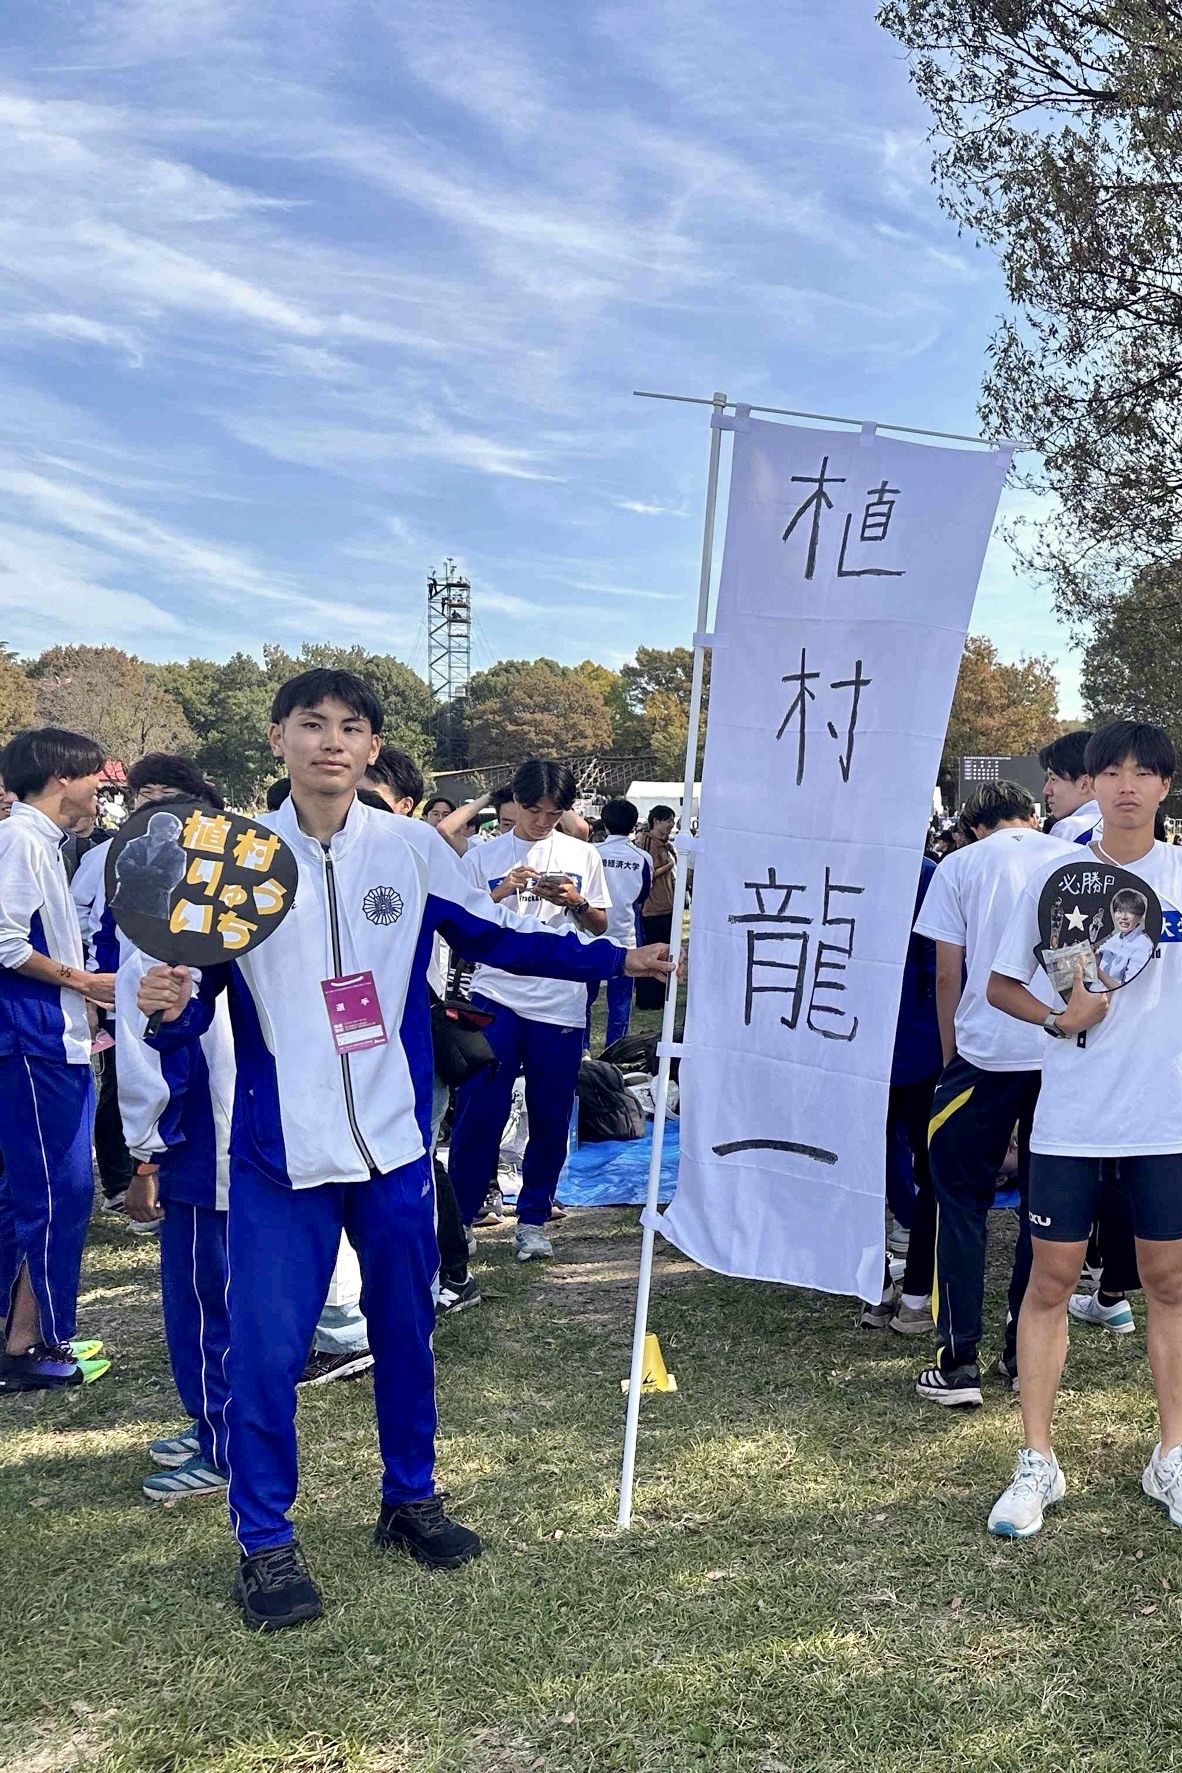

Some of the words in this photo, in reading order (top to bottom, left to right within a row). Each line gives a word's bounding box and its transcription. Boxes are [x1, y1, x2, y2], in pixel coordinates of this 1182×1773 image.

[711, 456, 905, 1164] 植村龍一
[183, 810, 281, 872] 植村
[186, 857, 288, 915] りゅう
[170, 898, 258, 950] いち
[1028, 1210, 1051, 1226] XU
